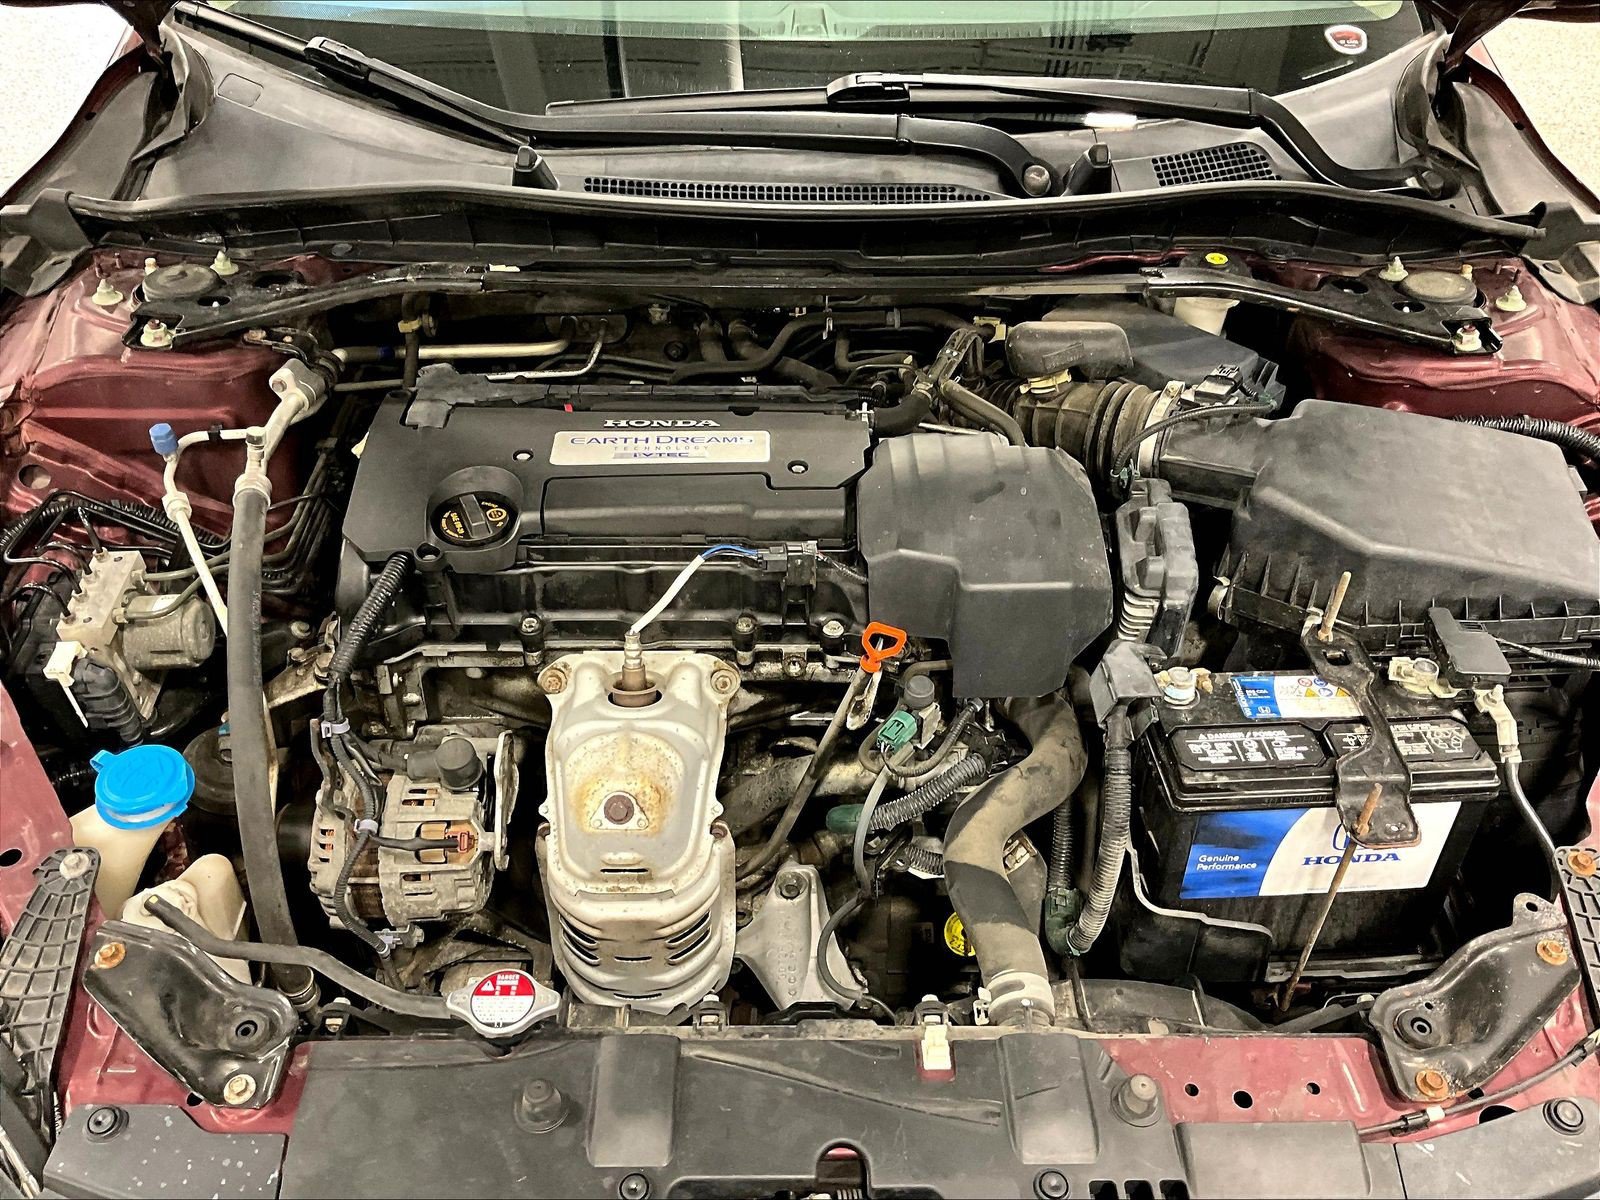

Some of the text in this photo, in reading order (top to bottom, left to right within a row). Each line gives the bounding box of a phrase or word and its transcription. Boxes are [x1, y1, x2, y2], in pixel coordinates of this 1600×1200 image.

[603, 419, 721, 428] HONDA
[570, 436, 649, 444] EARTH
[1207, 732, 1245, 740] DANGER
[1198, 854, 1240, 863] Genuine
[1196, 862, 1257, 871] Performance
